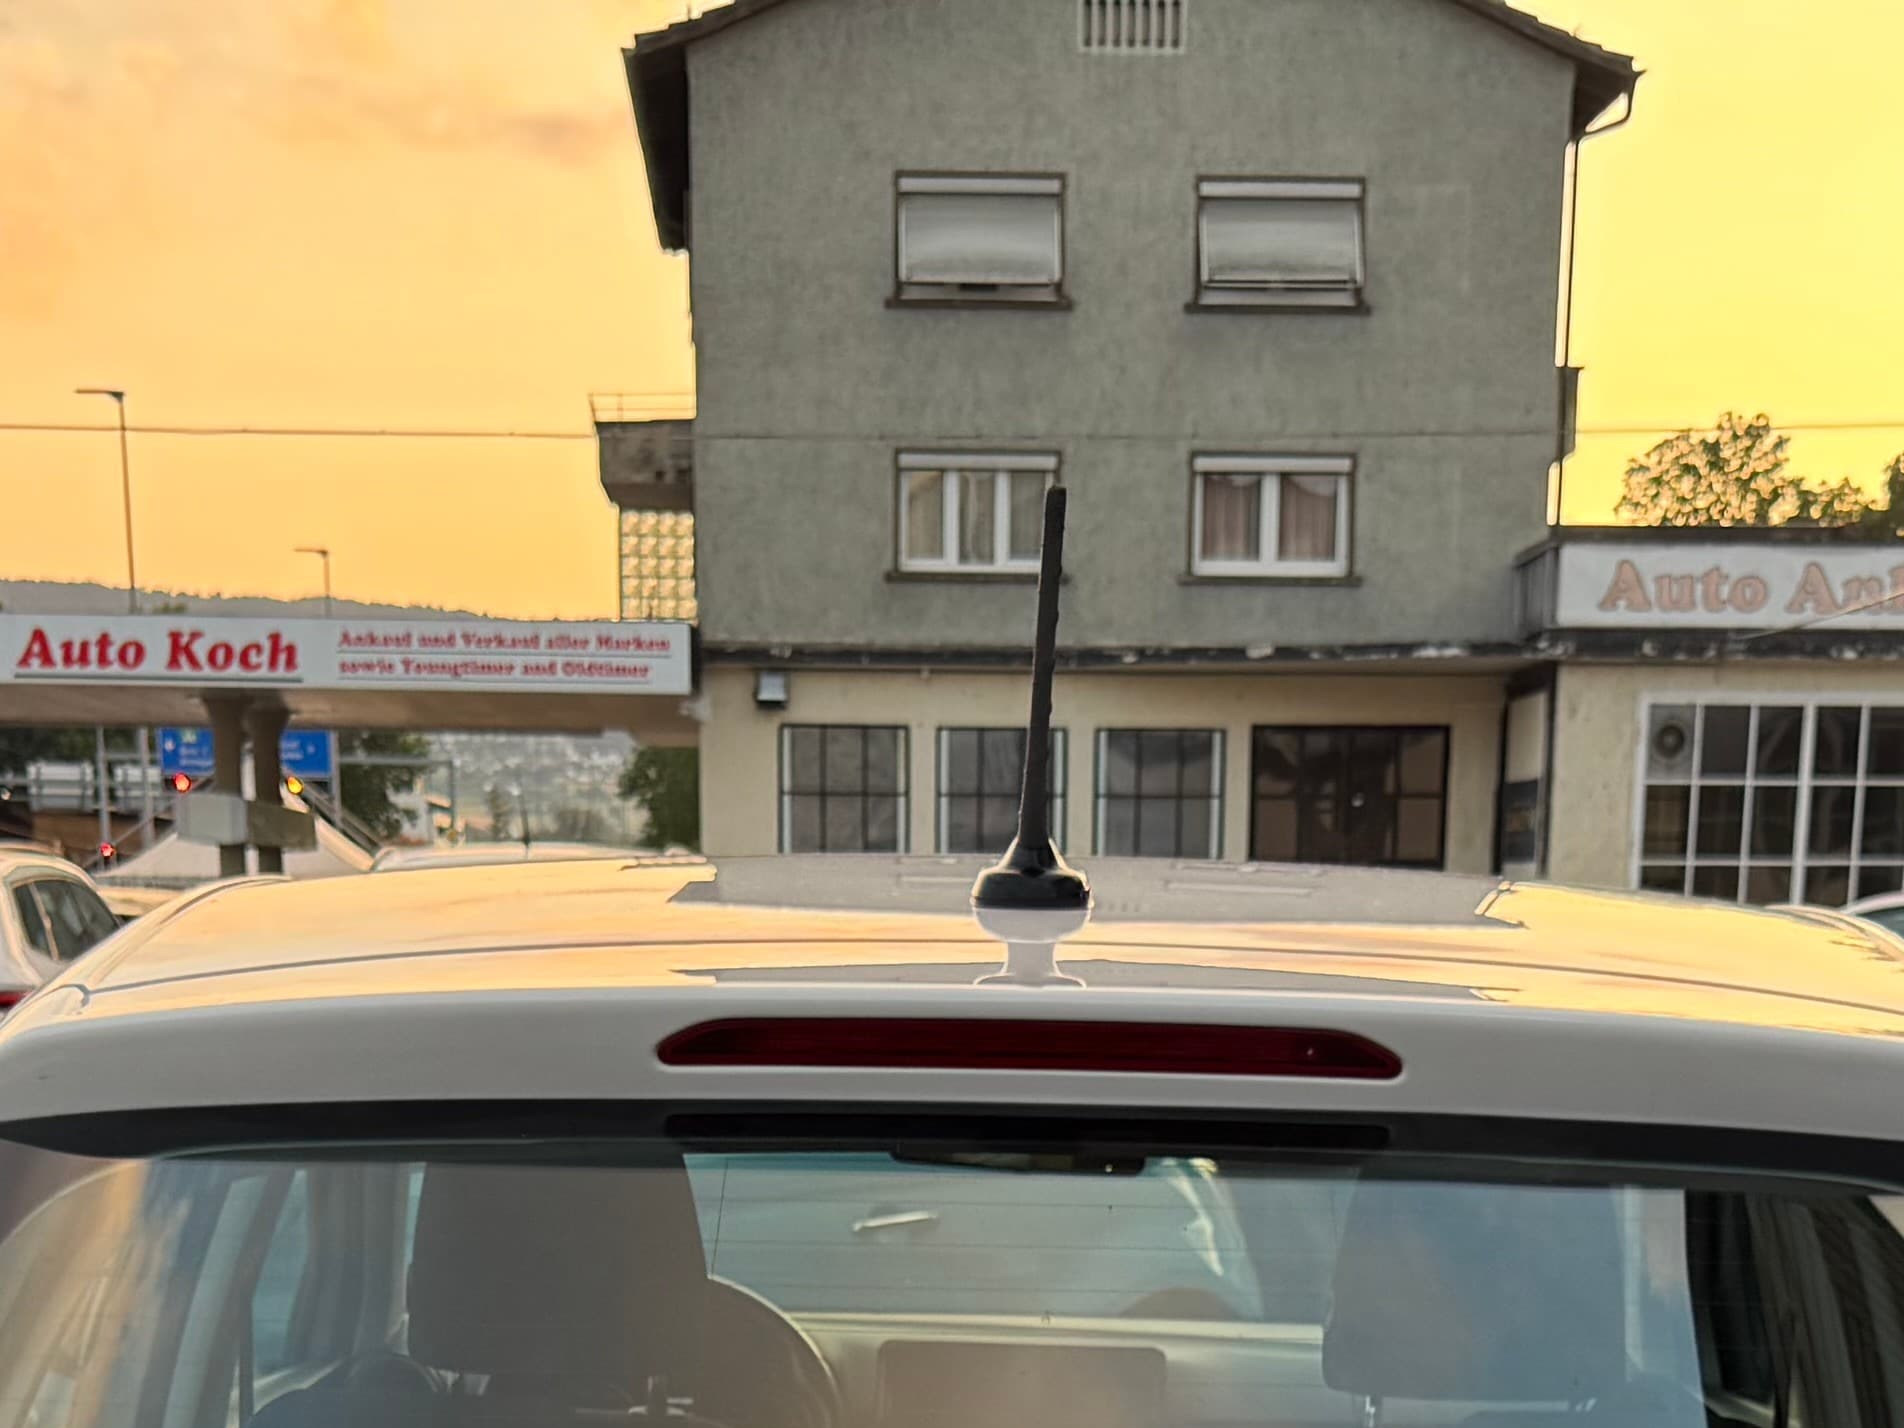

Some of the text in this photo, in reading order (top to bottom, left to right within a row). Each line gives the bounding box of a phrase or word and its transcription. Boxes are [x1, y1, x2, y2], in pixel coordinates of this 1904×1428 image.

[1599, 559, 1769, 614] Auto
[17, 625, 299, 672] Auto Koch
